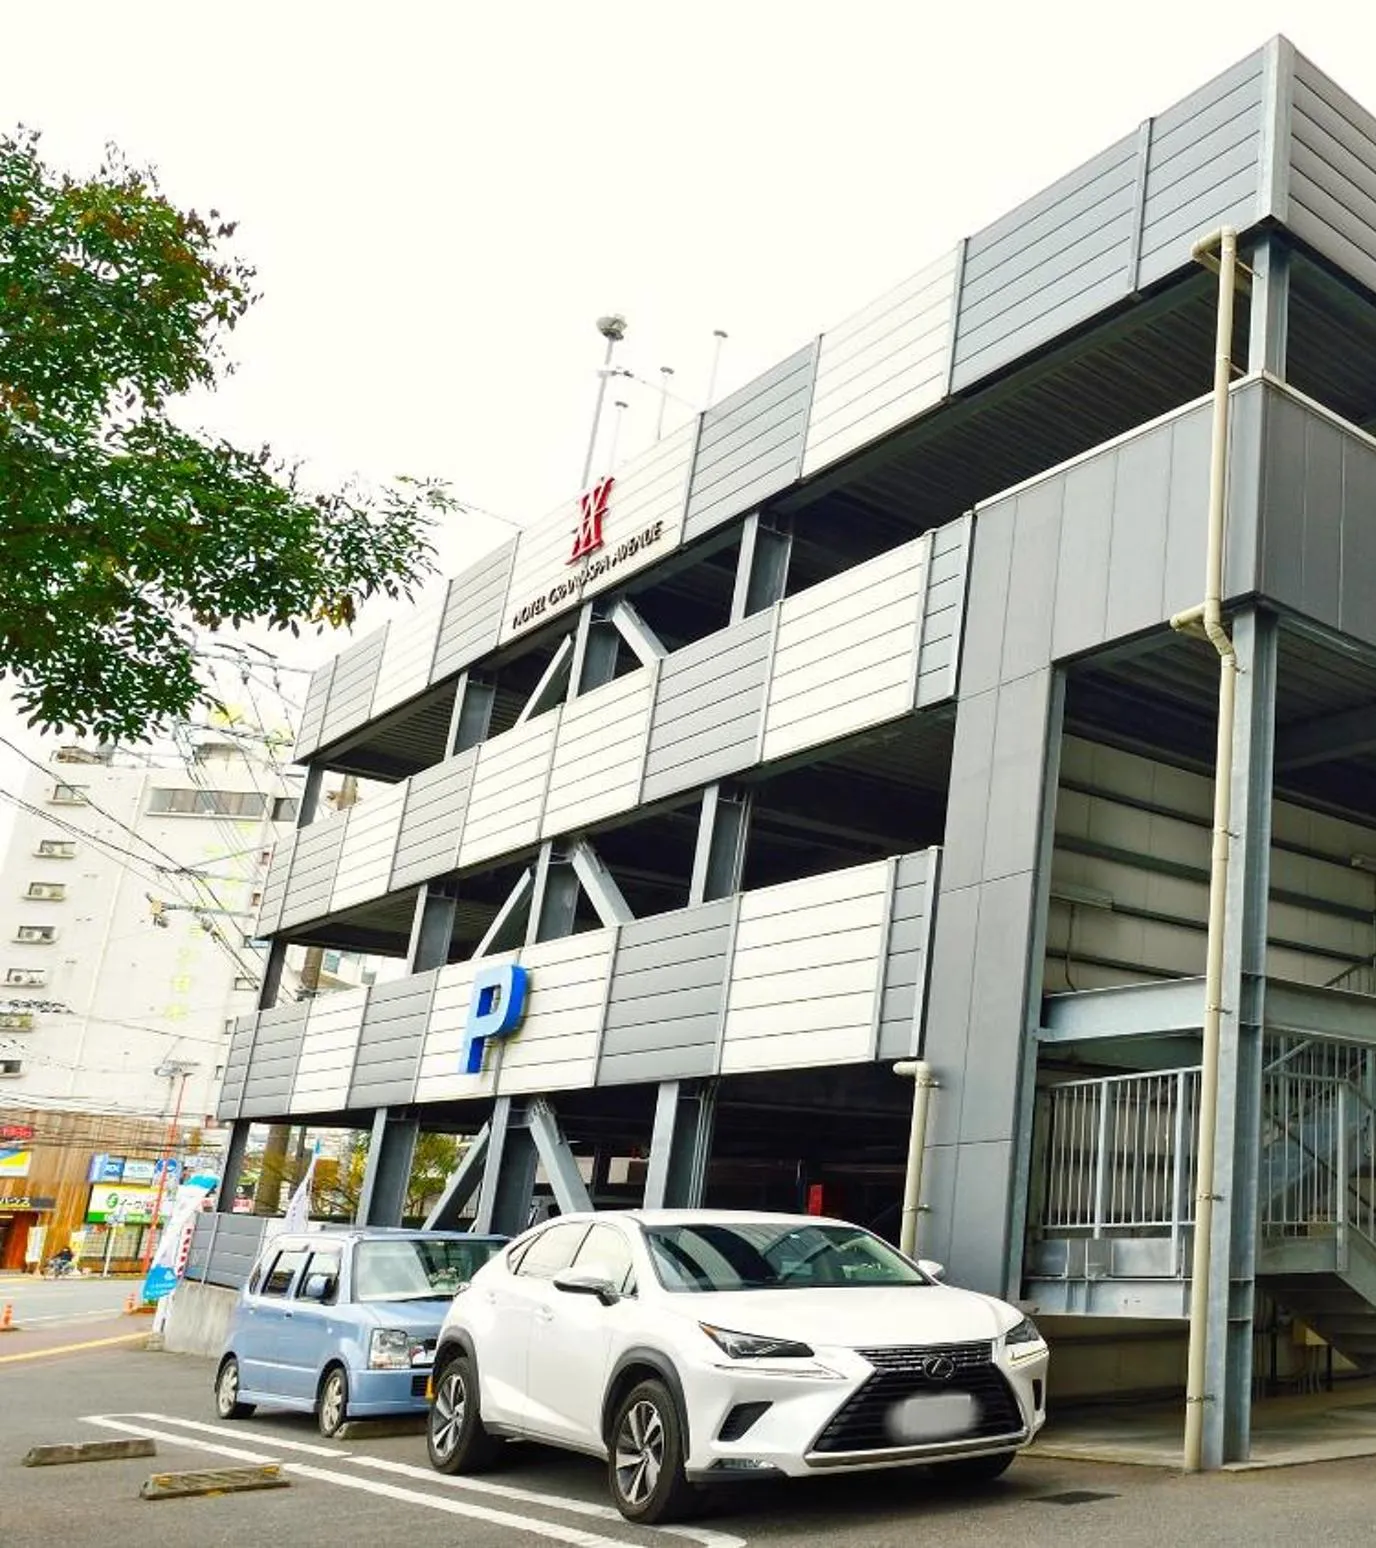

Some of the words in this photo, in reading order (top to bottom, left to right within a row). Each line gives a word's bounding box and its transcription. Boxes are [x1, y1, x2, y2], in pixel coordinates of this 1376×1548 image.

[512, 596, 547, 630] HOTEL
[611, 520, 664, 567] AVENUE
[458, 963, 530, 1075] P
